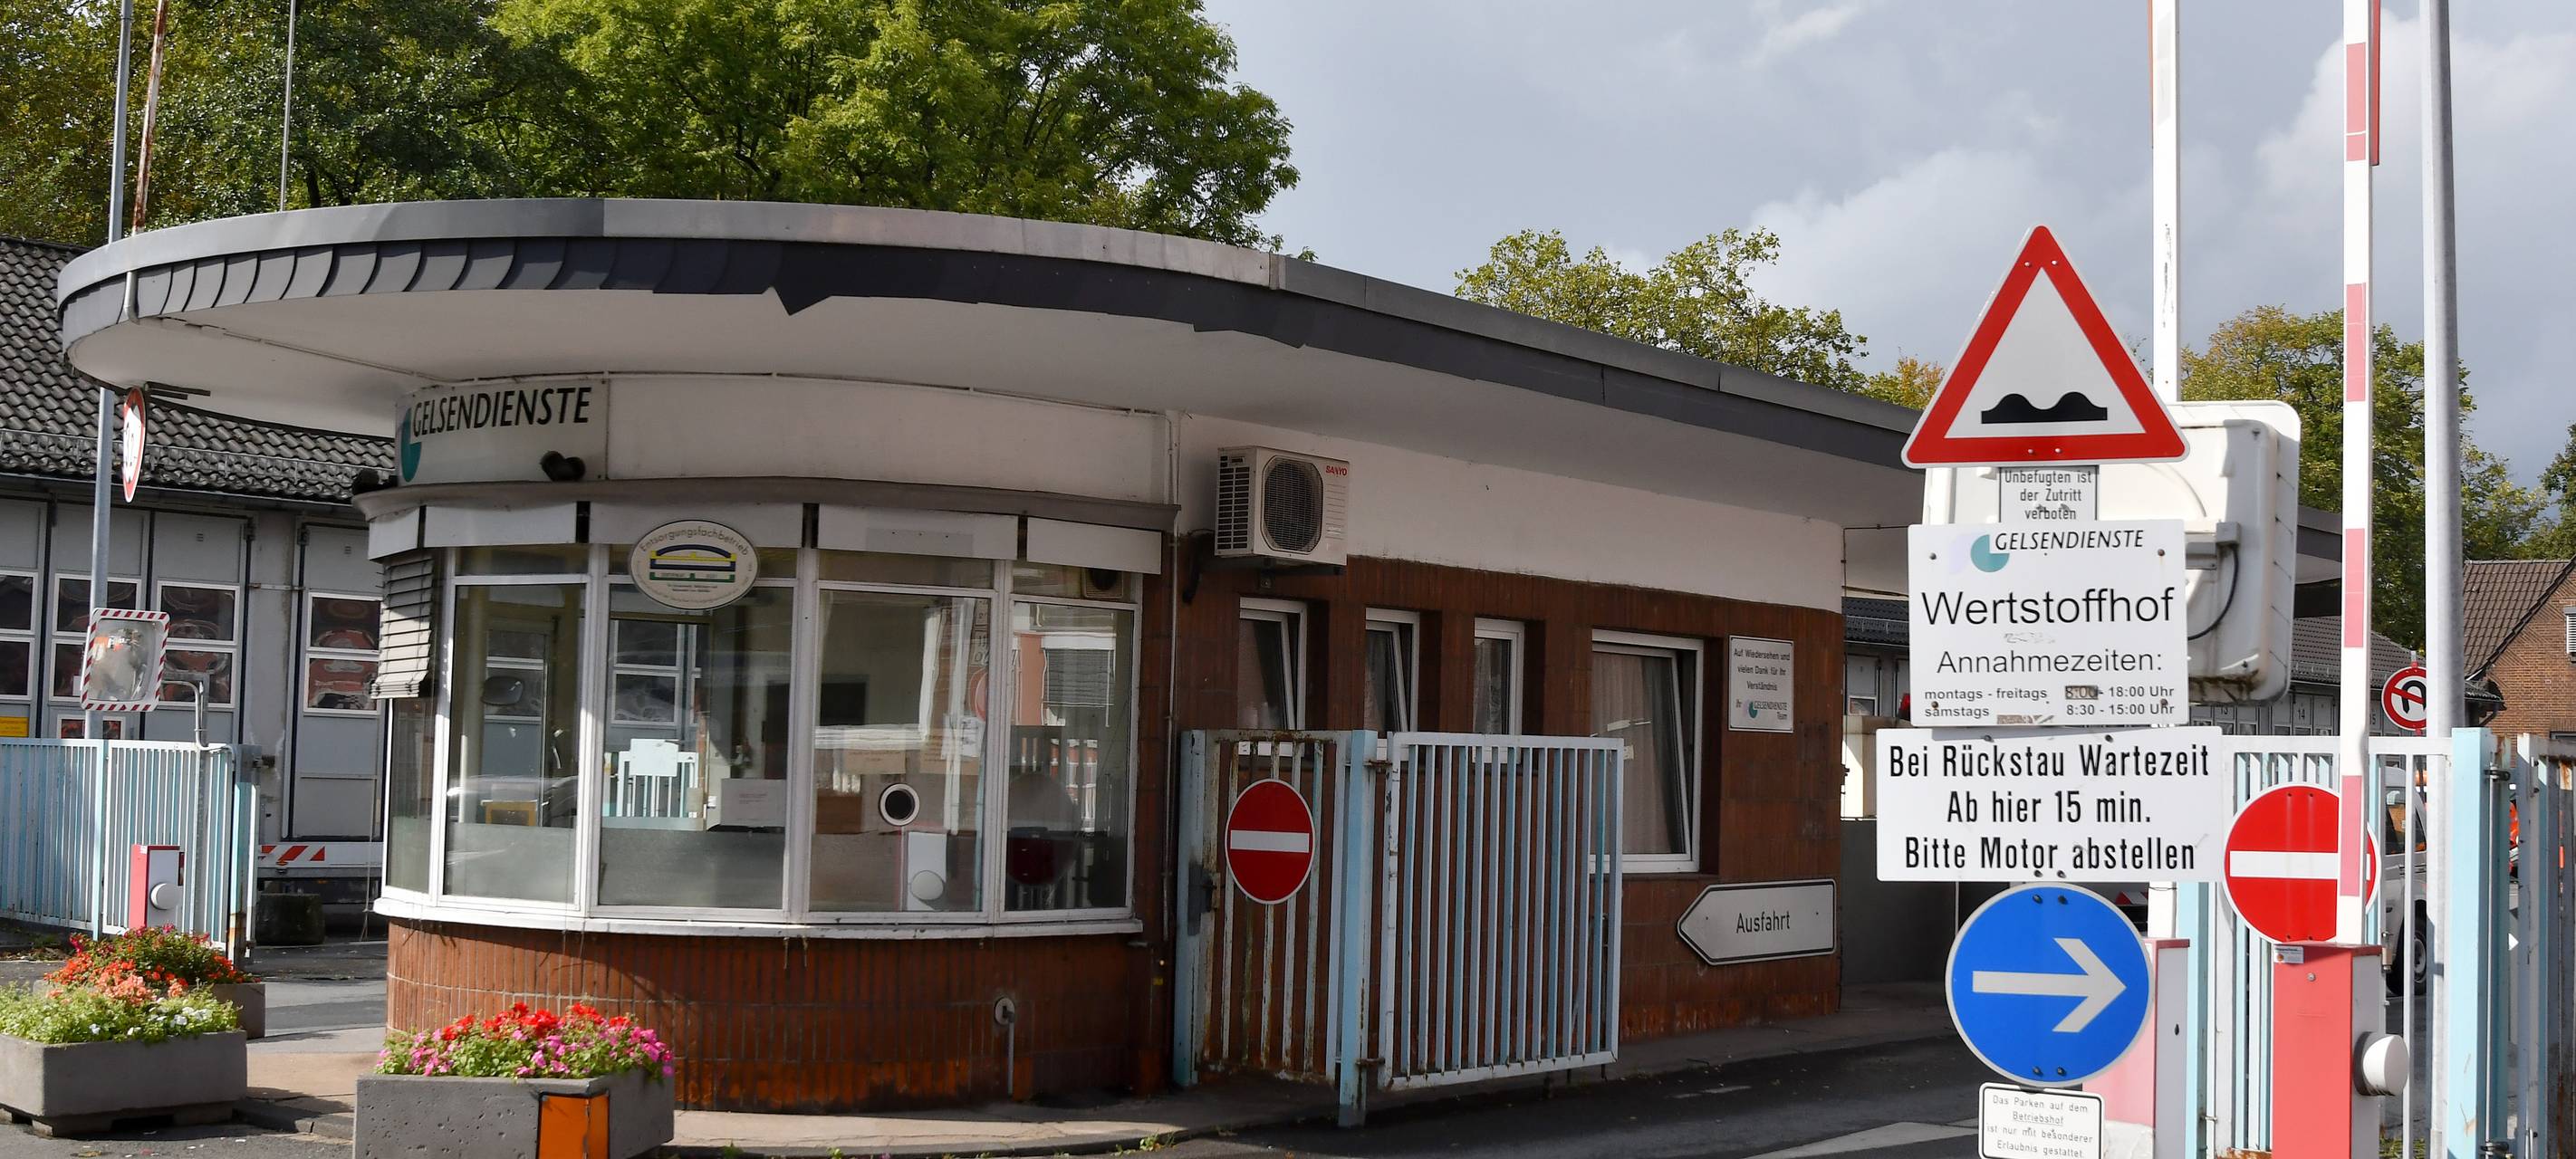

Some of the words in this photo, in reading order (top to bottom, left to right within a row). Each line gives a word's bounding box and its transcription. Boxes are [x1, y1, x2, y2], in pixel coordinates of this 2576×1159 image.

[413, 387, 592, 437] GELSENDIENSTE
[1325, 465, 1348, 476] SANYO
[2004, 470, 2071, 486] Unbefugten
[2078, 470, 2092, 483] ist
[2020, 488, 2039, 501] der
[2045, 488, 2082, 501] Zutritt
[2024, 506, 2076, 520] verboten
[1994, 530, 2145, 551] GELSENDIENSTE
[1921, 587, 2175, 625] Wertstoffhof
[1937, 649, 2162, 673] Annahmezeiten:
[1925, 689, 1984, 702] montags
[1996, 688, 2048, 701] freitags
[2109, 686, 2145, 697] 18:00
[2149, 685, 2174, 697] Uhr
[1925, 707, 1990, 719] samstags
[2066, 704, 2095, 715] 8:30
[2109, 704, 2145, 715] 15:00
[2149, 704, 2174, 714] Uhr
[1889, 745, 1927, 777] Bei
[1943, 744, 2064, 777] Rückstau
[2079, 743, 2210, 776] Wartezeit
[1947, 790, 1978, 823] Ab
[1992, 790, 2042, 823] hier
[2054, 790, 2081, 823] 15
[2097, 790, 2151, 823] min.
[1905, 837, 1966, 868] Bitte
[1980, 837, 2058, 868] Motor
[2072, 837, 2195, 869] abstellen
[1735, 910, 1791, 934] Ausfahrt
[1993, 1094, 2009, 1105] Das
[2014, 1097, 2044, 1108] Parken
[2050, 1100, 2064, 1110] auf
[2069, 1102, 2088, 1113] dem
[2013, 1111, 2064, 1125] Betriebshof
[1986, 1123, 1998, 1134] ist
[2003, 1126, 2016, 1135] nur
[2022, 1126, 2037, 1137] mit
[2041, 1130, 2093, 1144] besonderer
[1996, 1139, 2038, 1153] Erlaubnis
